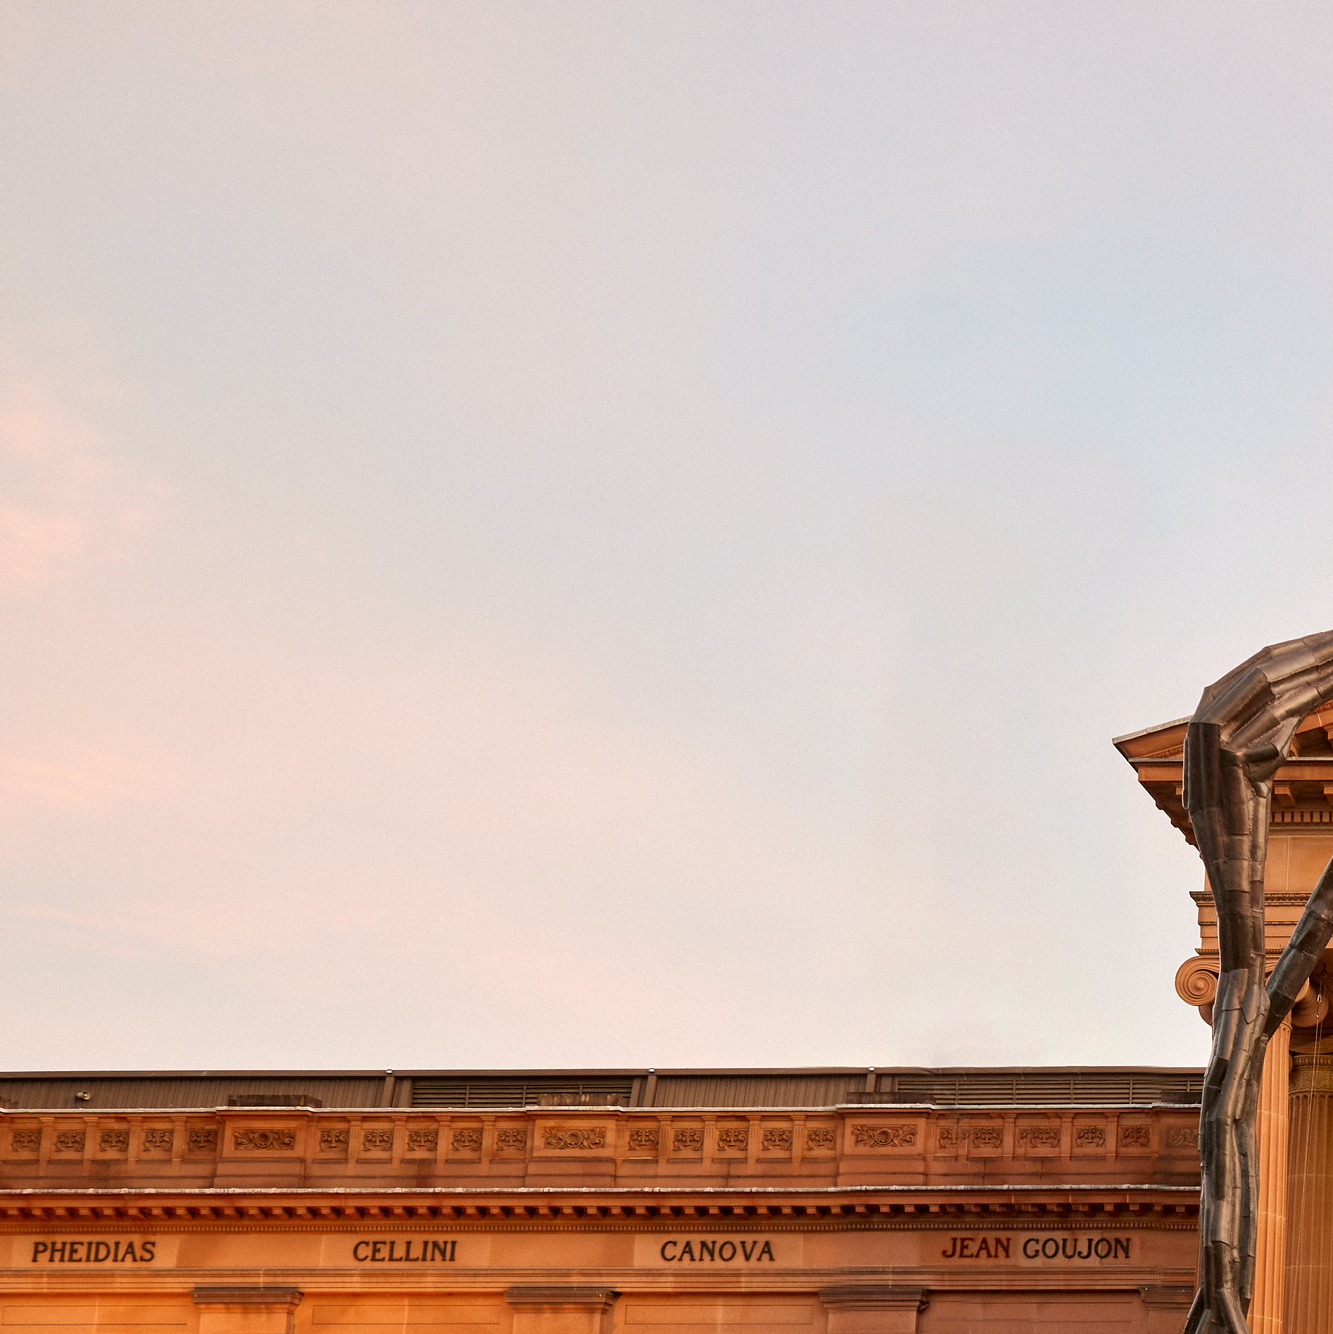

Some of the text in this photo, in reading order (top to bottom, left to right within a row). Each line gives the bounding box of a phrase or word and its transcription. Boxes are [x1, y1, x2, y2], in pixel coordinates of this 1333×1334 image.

[31, 1240, 157, 1264] PHEIDIAS
[352, 1240, 458, 1263] CELLINI
[660, 1240, 776, 1263] CANOVA
[941, 1236, 1132, 1261] JEAN GOUJON
